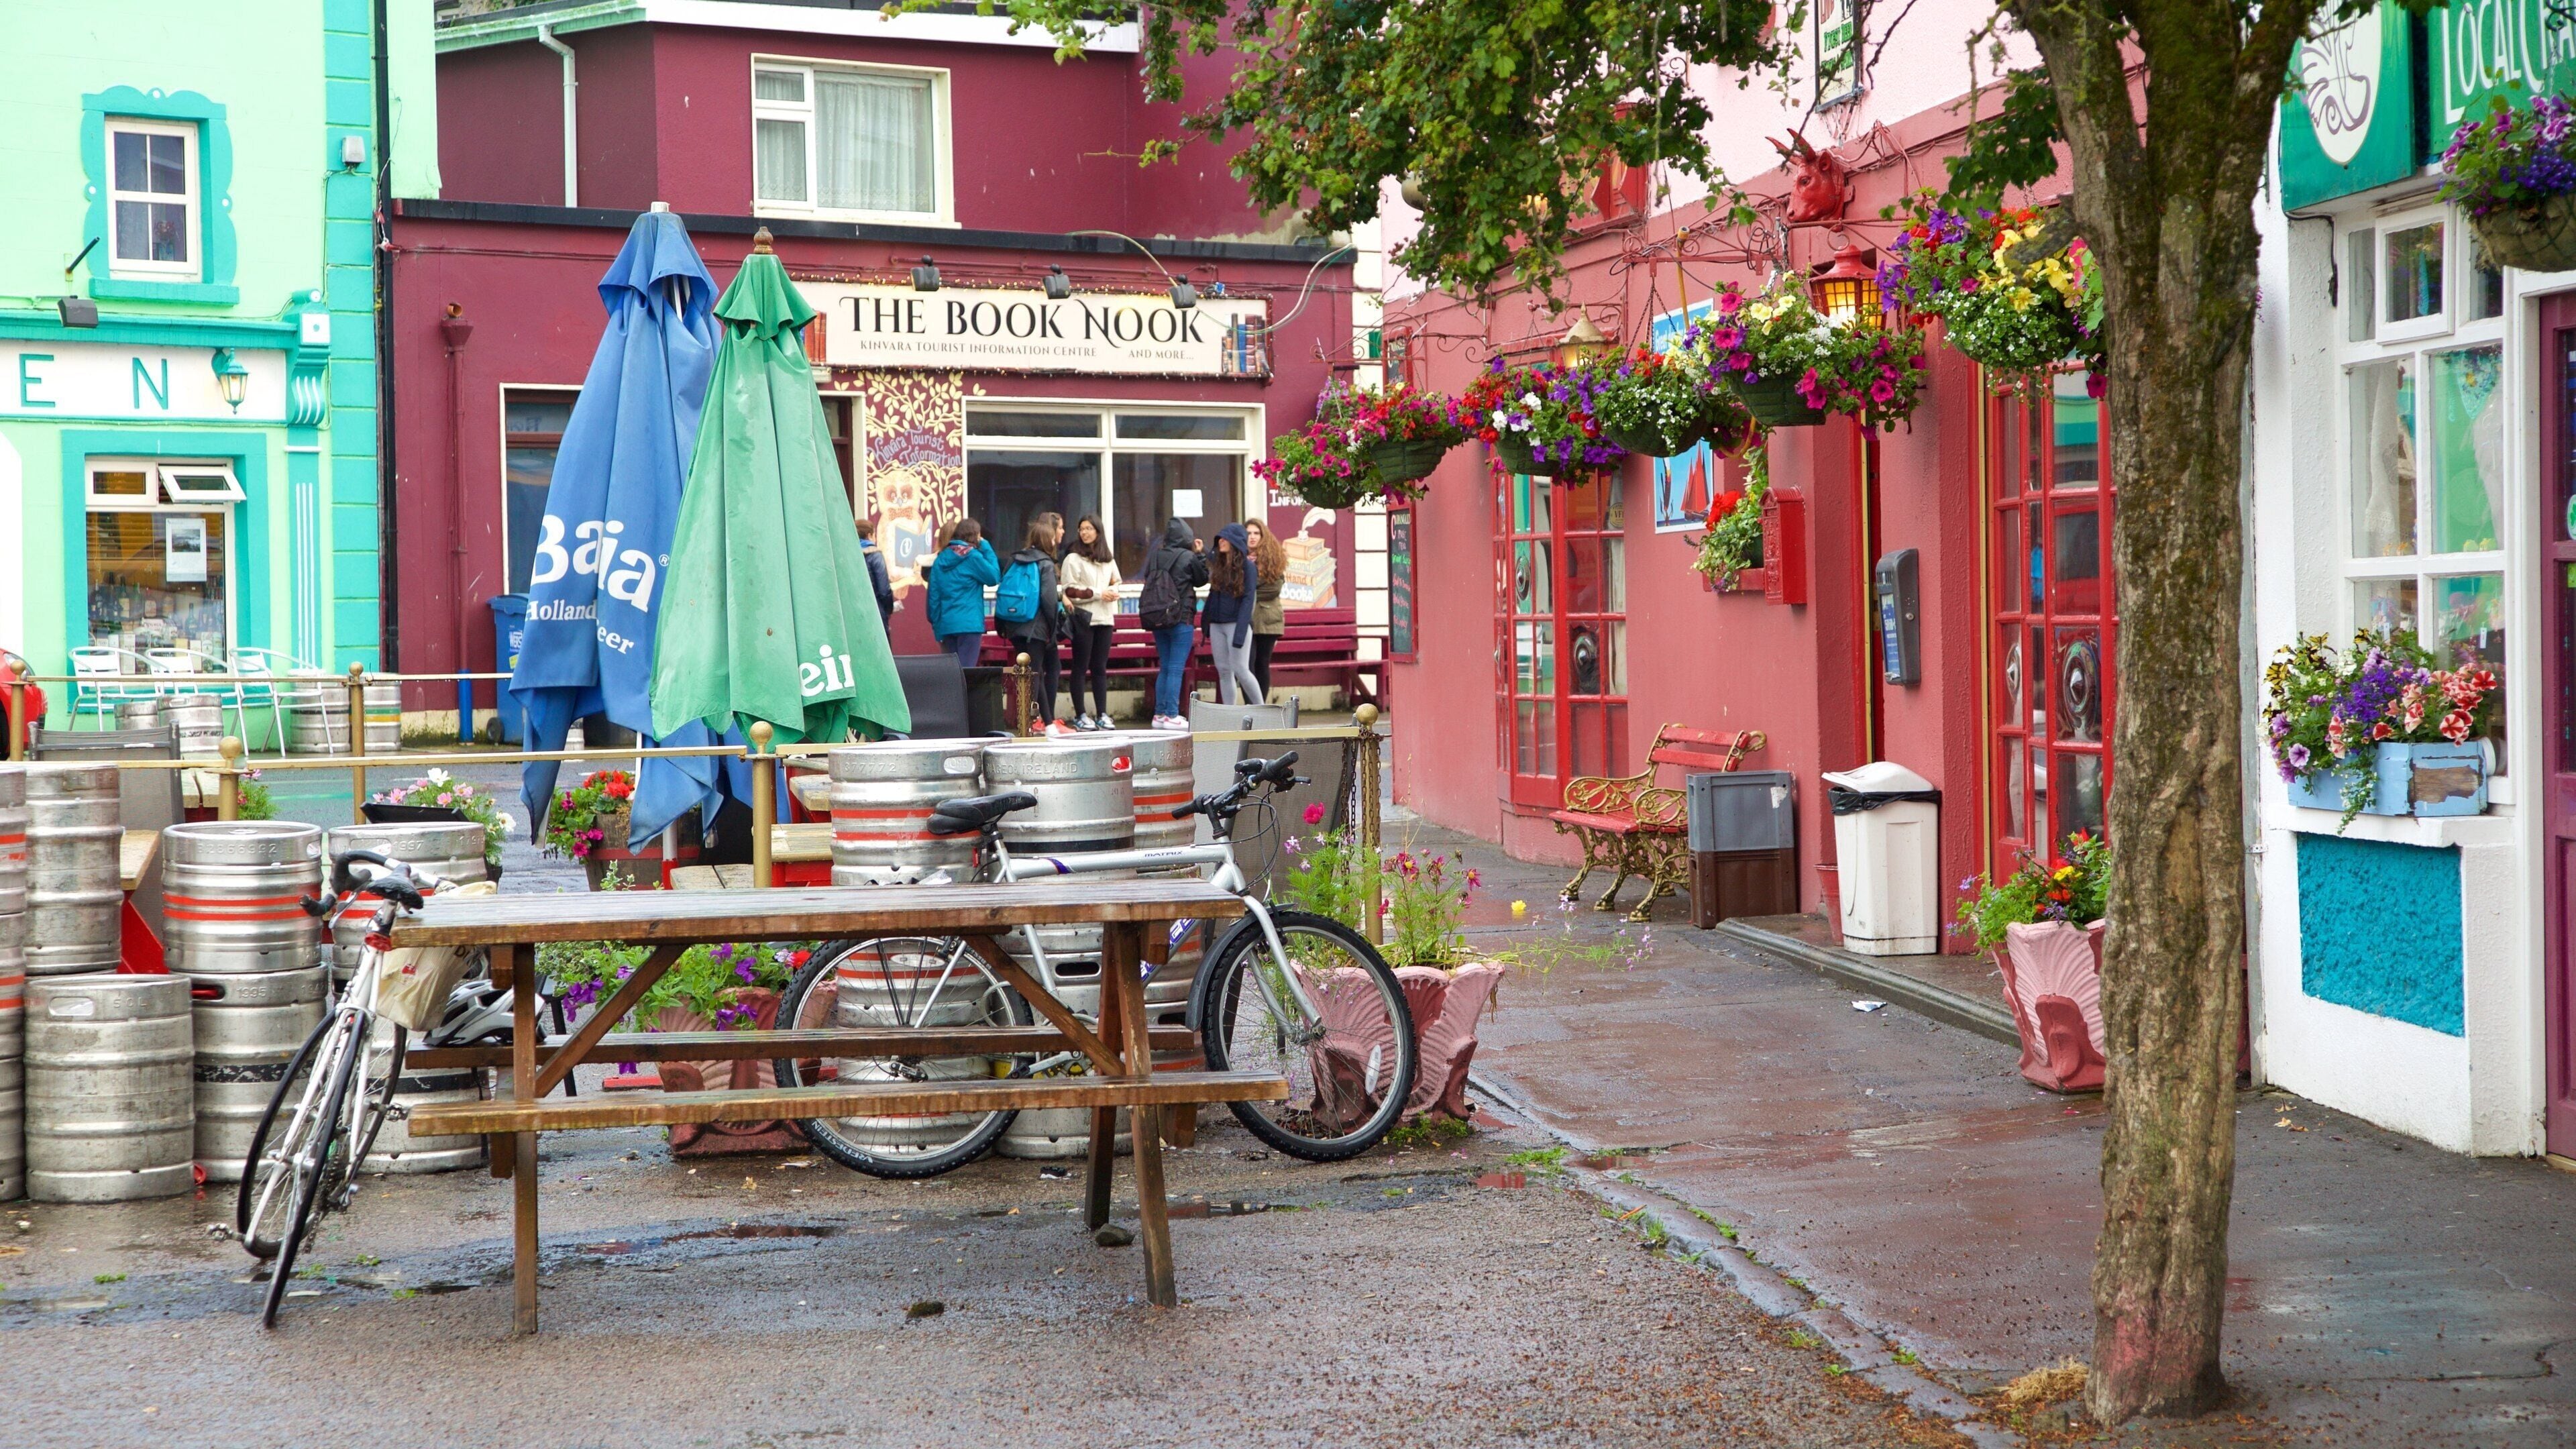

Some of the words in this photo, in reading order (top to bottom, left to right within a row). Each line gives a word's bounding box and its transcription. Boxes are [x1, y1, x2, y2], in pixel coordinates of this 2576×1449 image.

[839, 296, 926, 334] THE
[945, 300, 1065, 338] BOOK
[1073, 299, 1205, 349] NOOK
[861, 340, 912, 352] KINVARA
[915, 341, 966, 353] TOURIST
[969, 343, 1050, 356] INFORMATION
[1053, 345, 1097, 357] CENTRE
[1128, 349, 1152, 359] AND
[867, 437, 907, 468] Kinvara
[904, 425, 945, 451] Tourist
[899, 445, 962, 468] Information
[1286, 572, 1307, 585] Hand
[1279, 582, 1313, 602] Books
[596, 619, 635, 655] eer
[1022, 761, 1079, 775] IRELAND
[811, 1120, 873, 1164] VREDESTEIN
